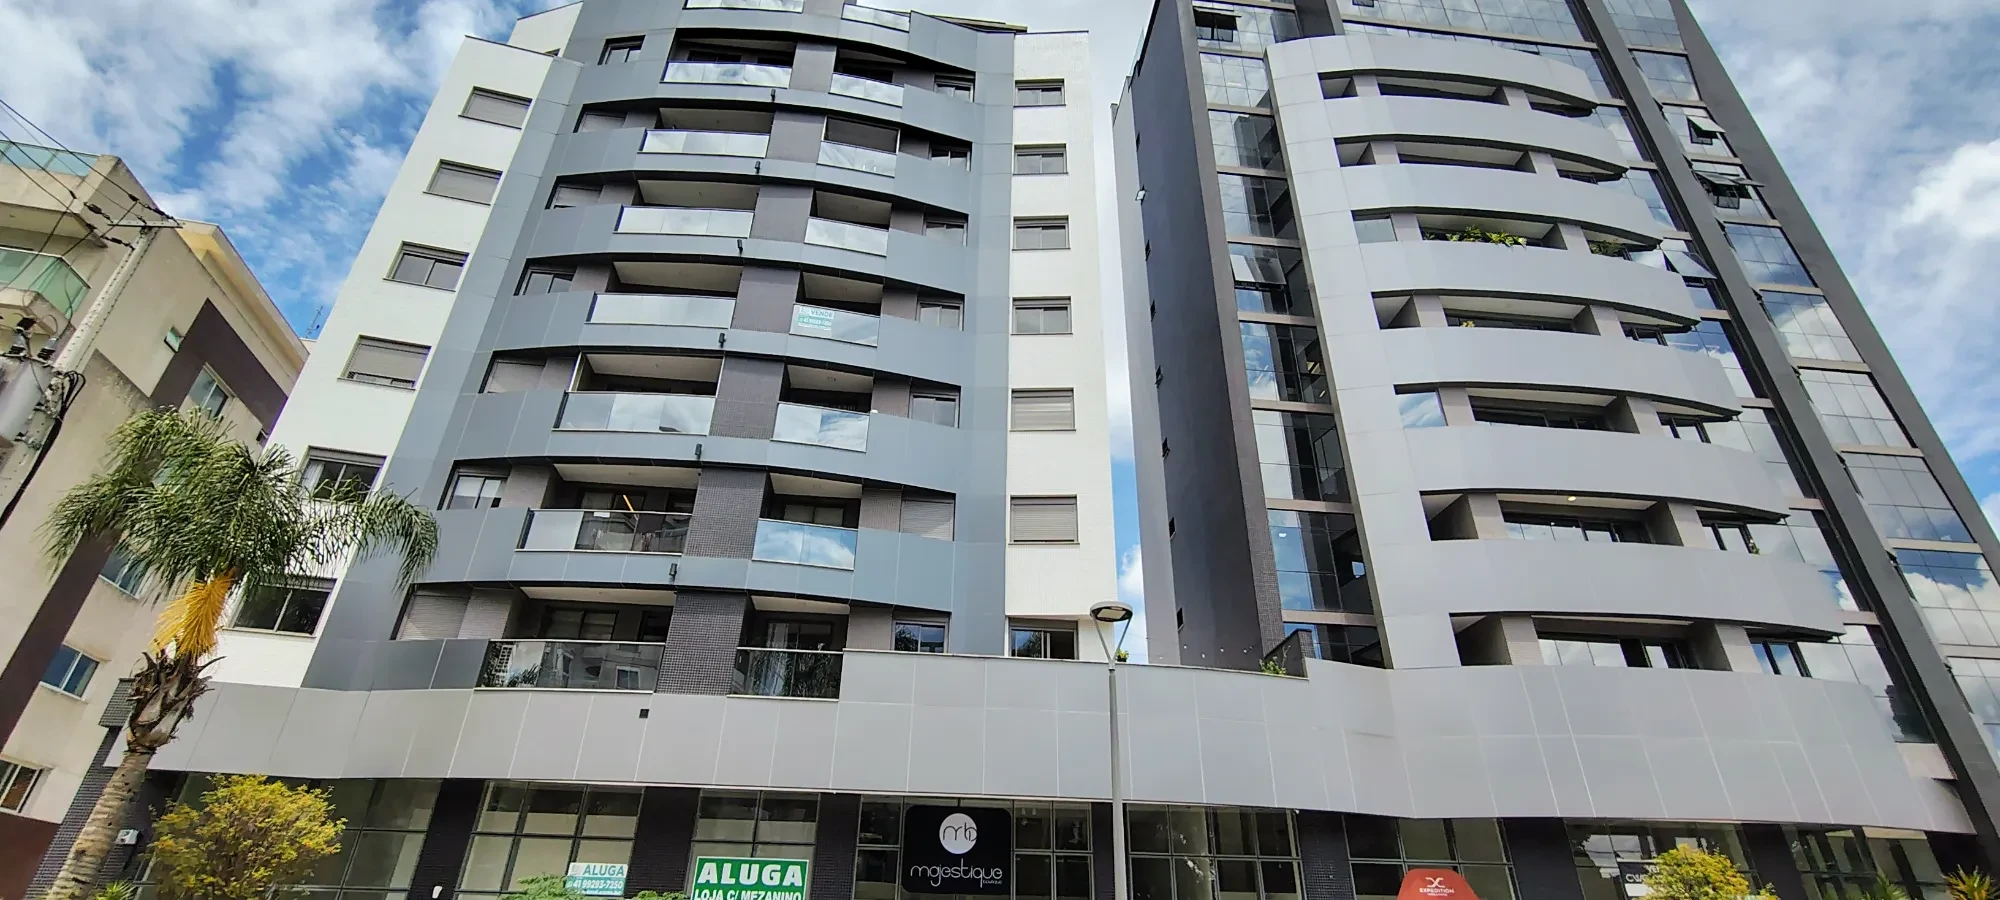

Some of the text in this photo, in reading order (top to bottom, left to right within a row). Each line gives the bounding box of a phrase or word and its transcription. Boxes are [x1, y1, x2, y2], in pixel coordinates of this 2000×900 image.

[811, 309, 833, 318] VENDE
[582, 864, 625, 876] ALUGA
[697, 862, 803, 886] ALUGA
[910, 858, 1003, 888] majestique
[572, 879, 583, 888] 41
[693, 889, 802, 900] LOJA C/ MEZANINO
